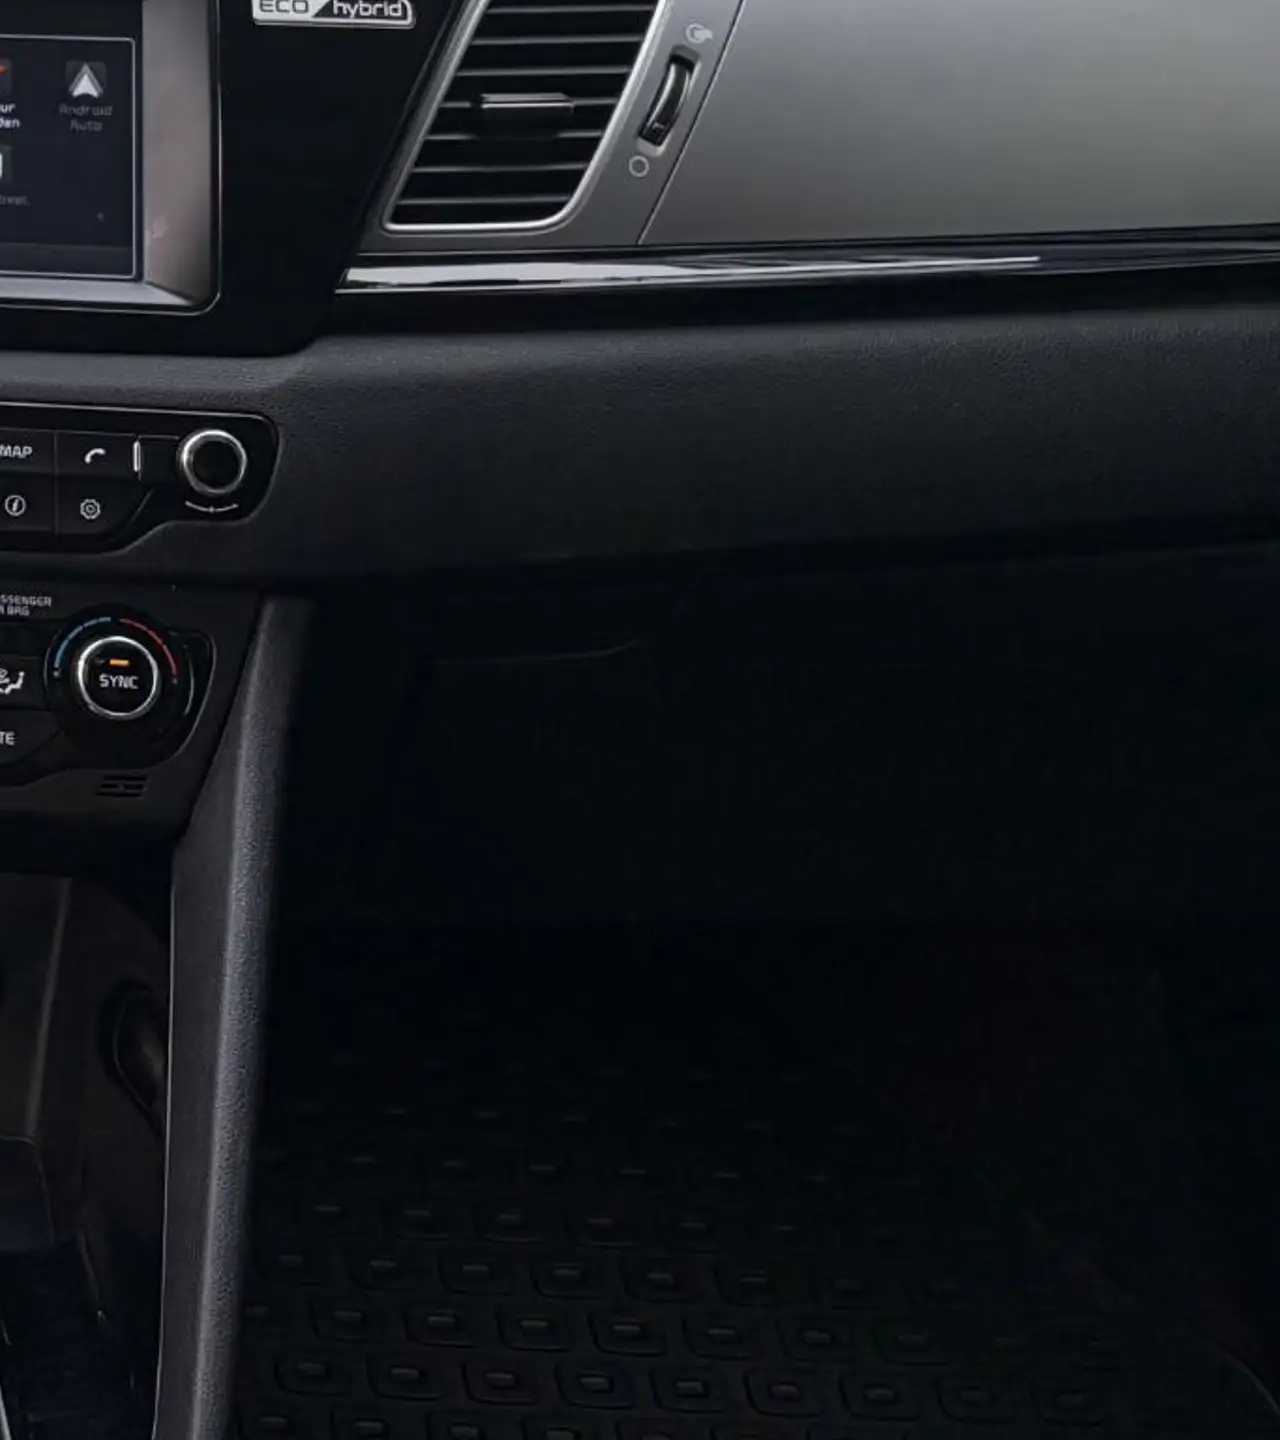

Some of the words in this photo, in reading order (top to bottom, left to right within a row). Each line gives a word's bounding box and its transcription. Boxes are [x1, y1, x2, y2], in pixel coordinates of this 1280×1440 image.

[333, 0, 402, 18] hybrid
[0, 445, 33, 459] MAP
[99, 674, 139, 690] SYNC
